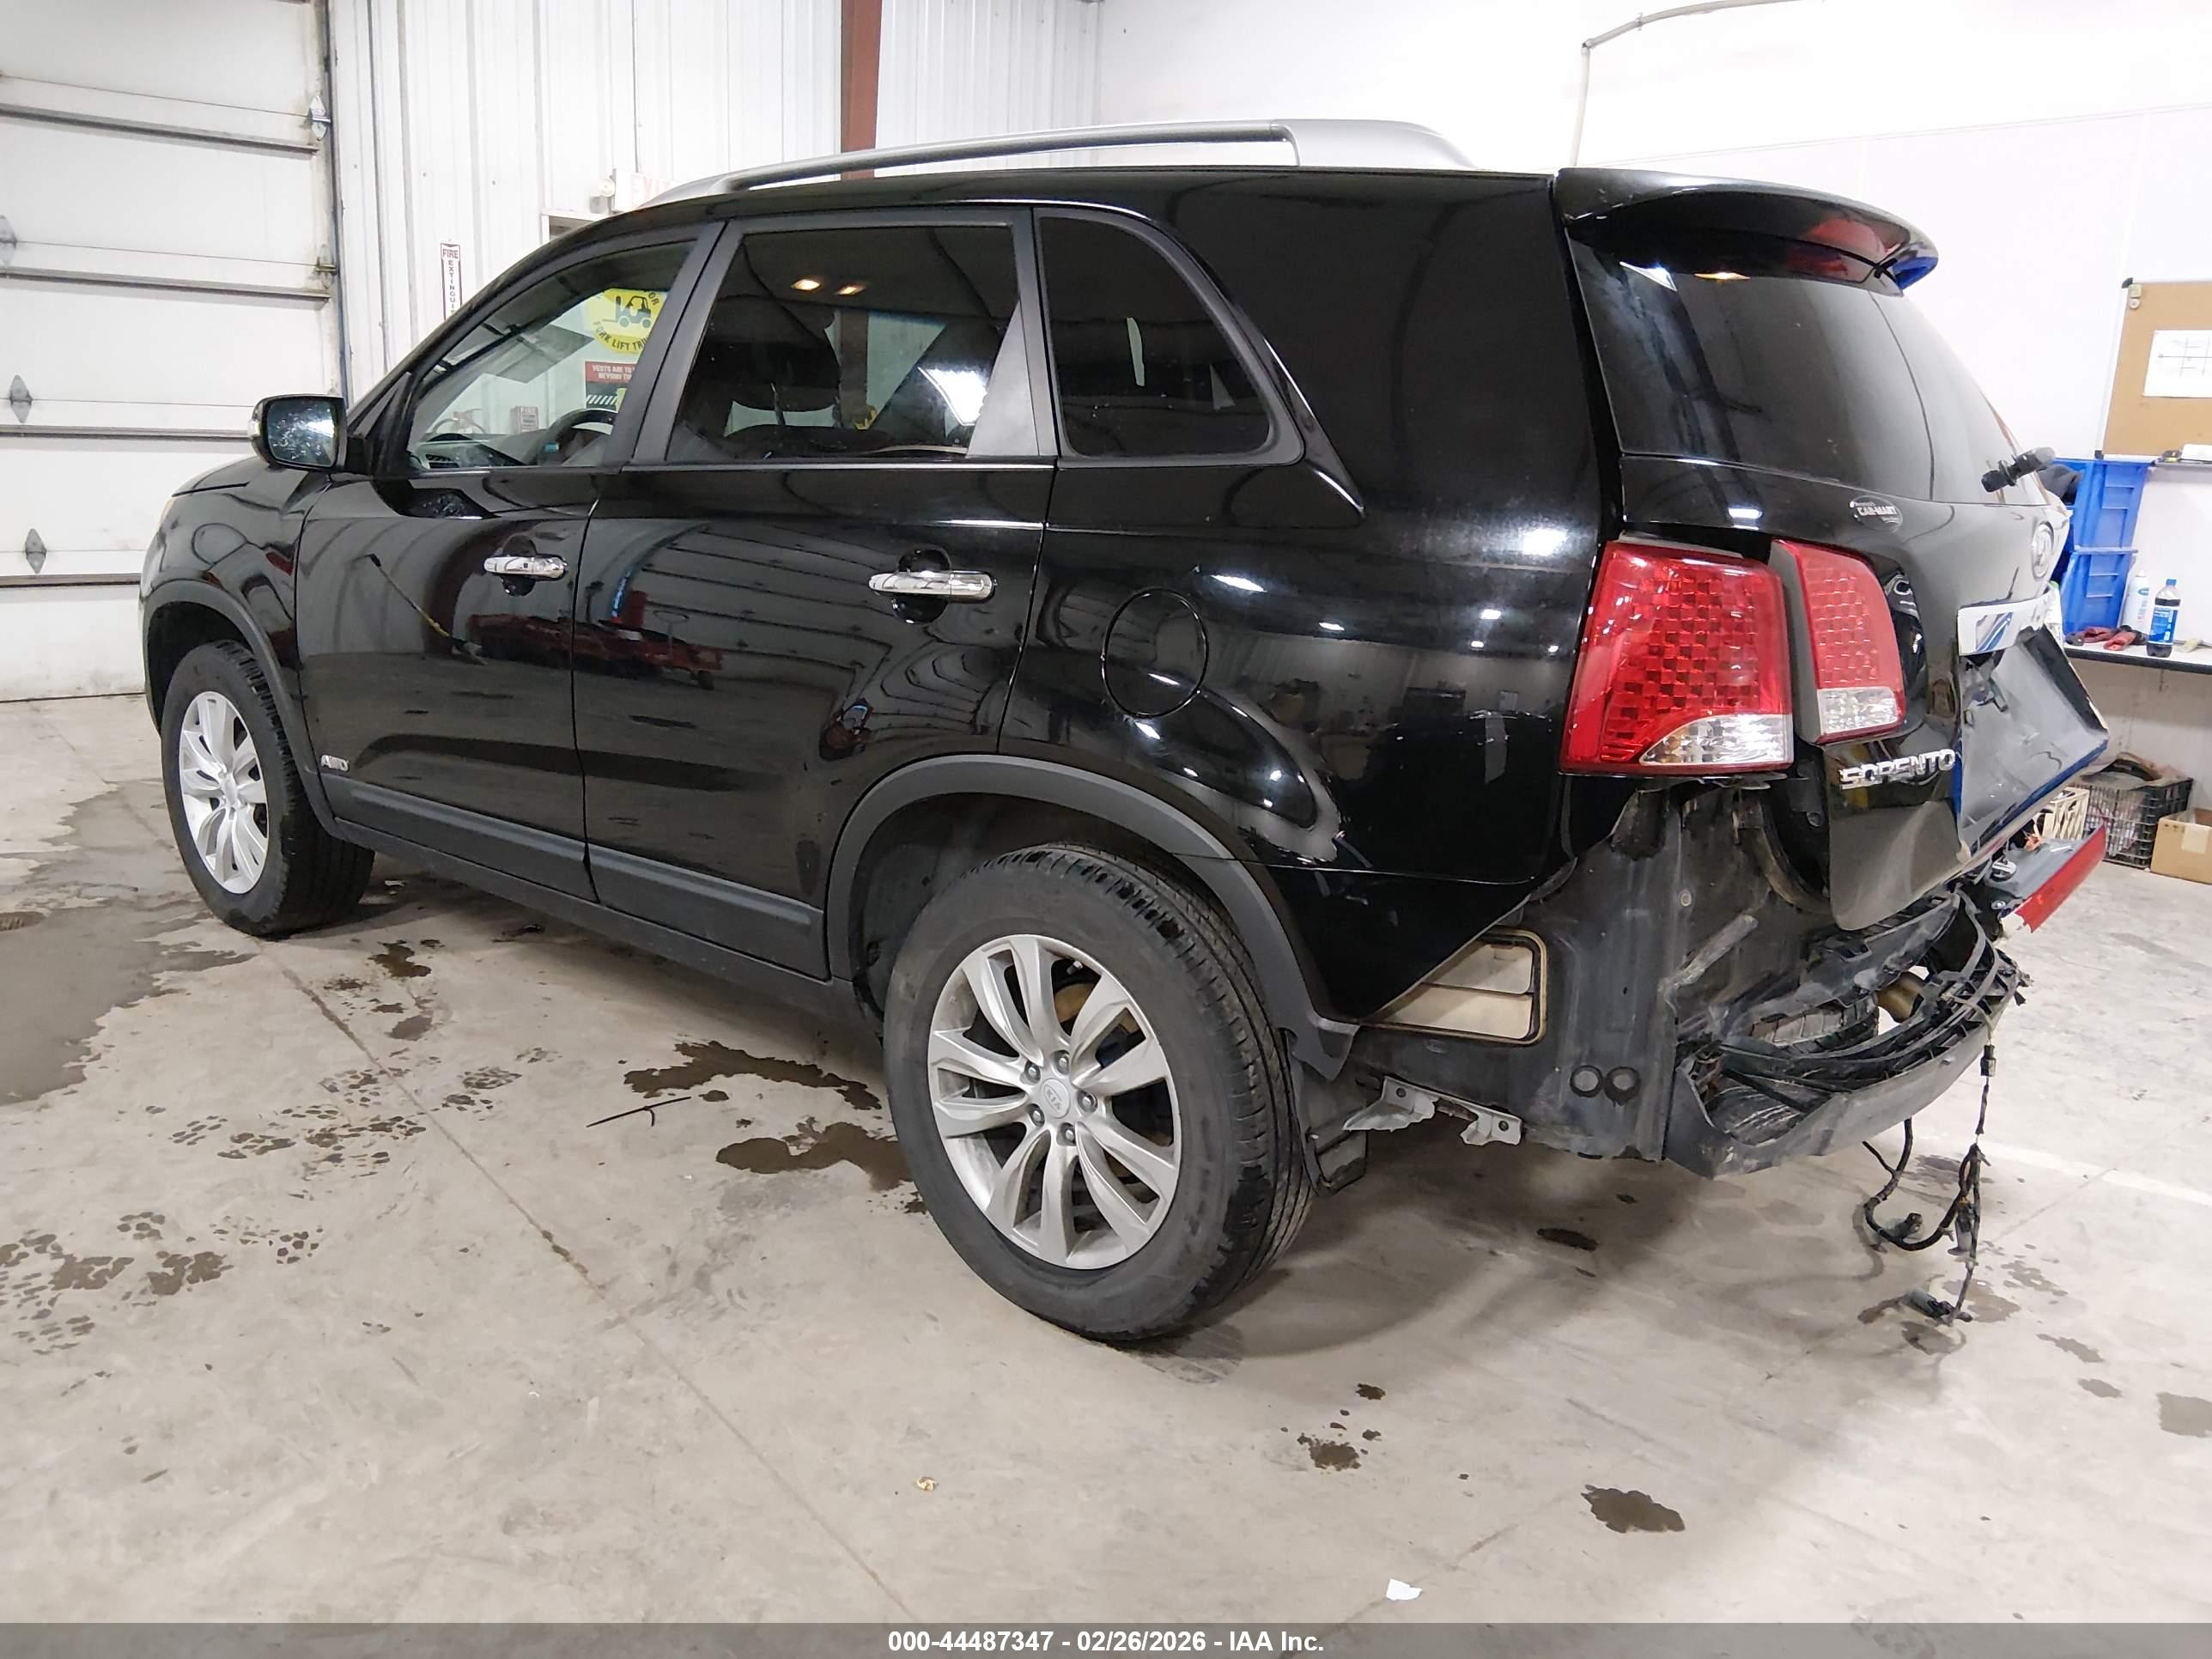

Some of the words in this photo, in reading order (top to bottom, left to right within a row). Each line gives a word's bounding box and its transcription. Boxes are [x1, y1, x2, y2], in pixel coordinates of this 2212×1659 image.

[442, 249, 459, 258] FIRE
[592, 321, 612, 343] FORK
[611, 339, 630, 351] LIFT
[321, 754, 349, 772] AWD
[1838, 748, 1956, 790] SORENTO
